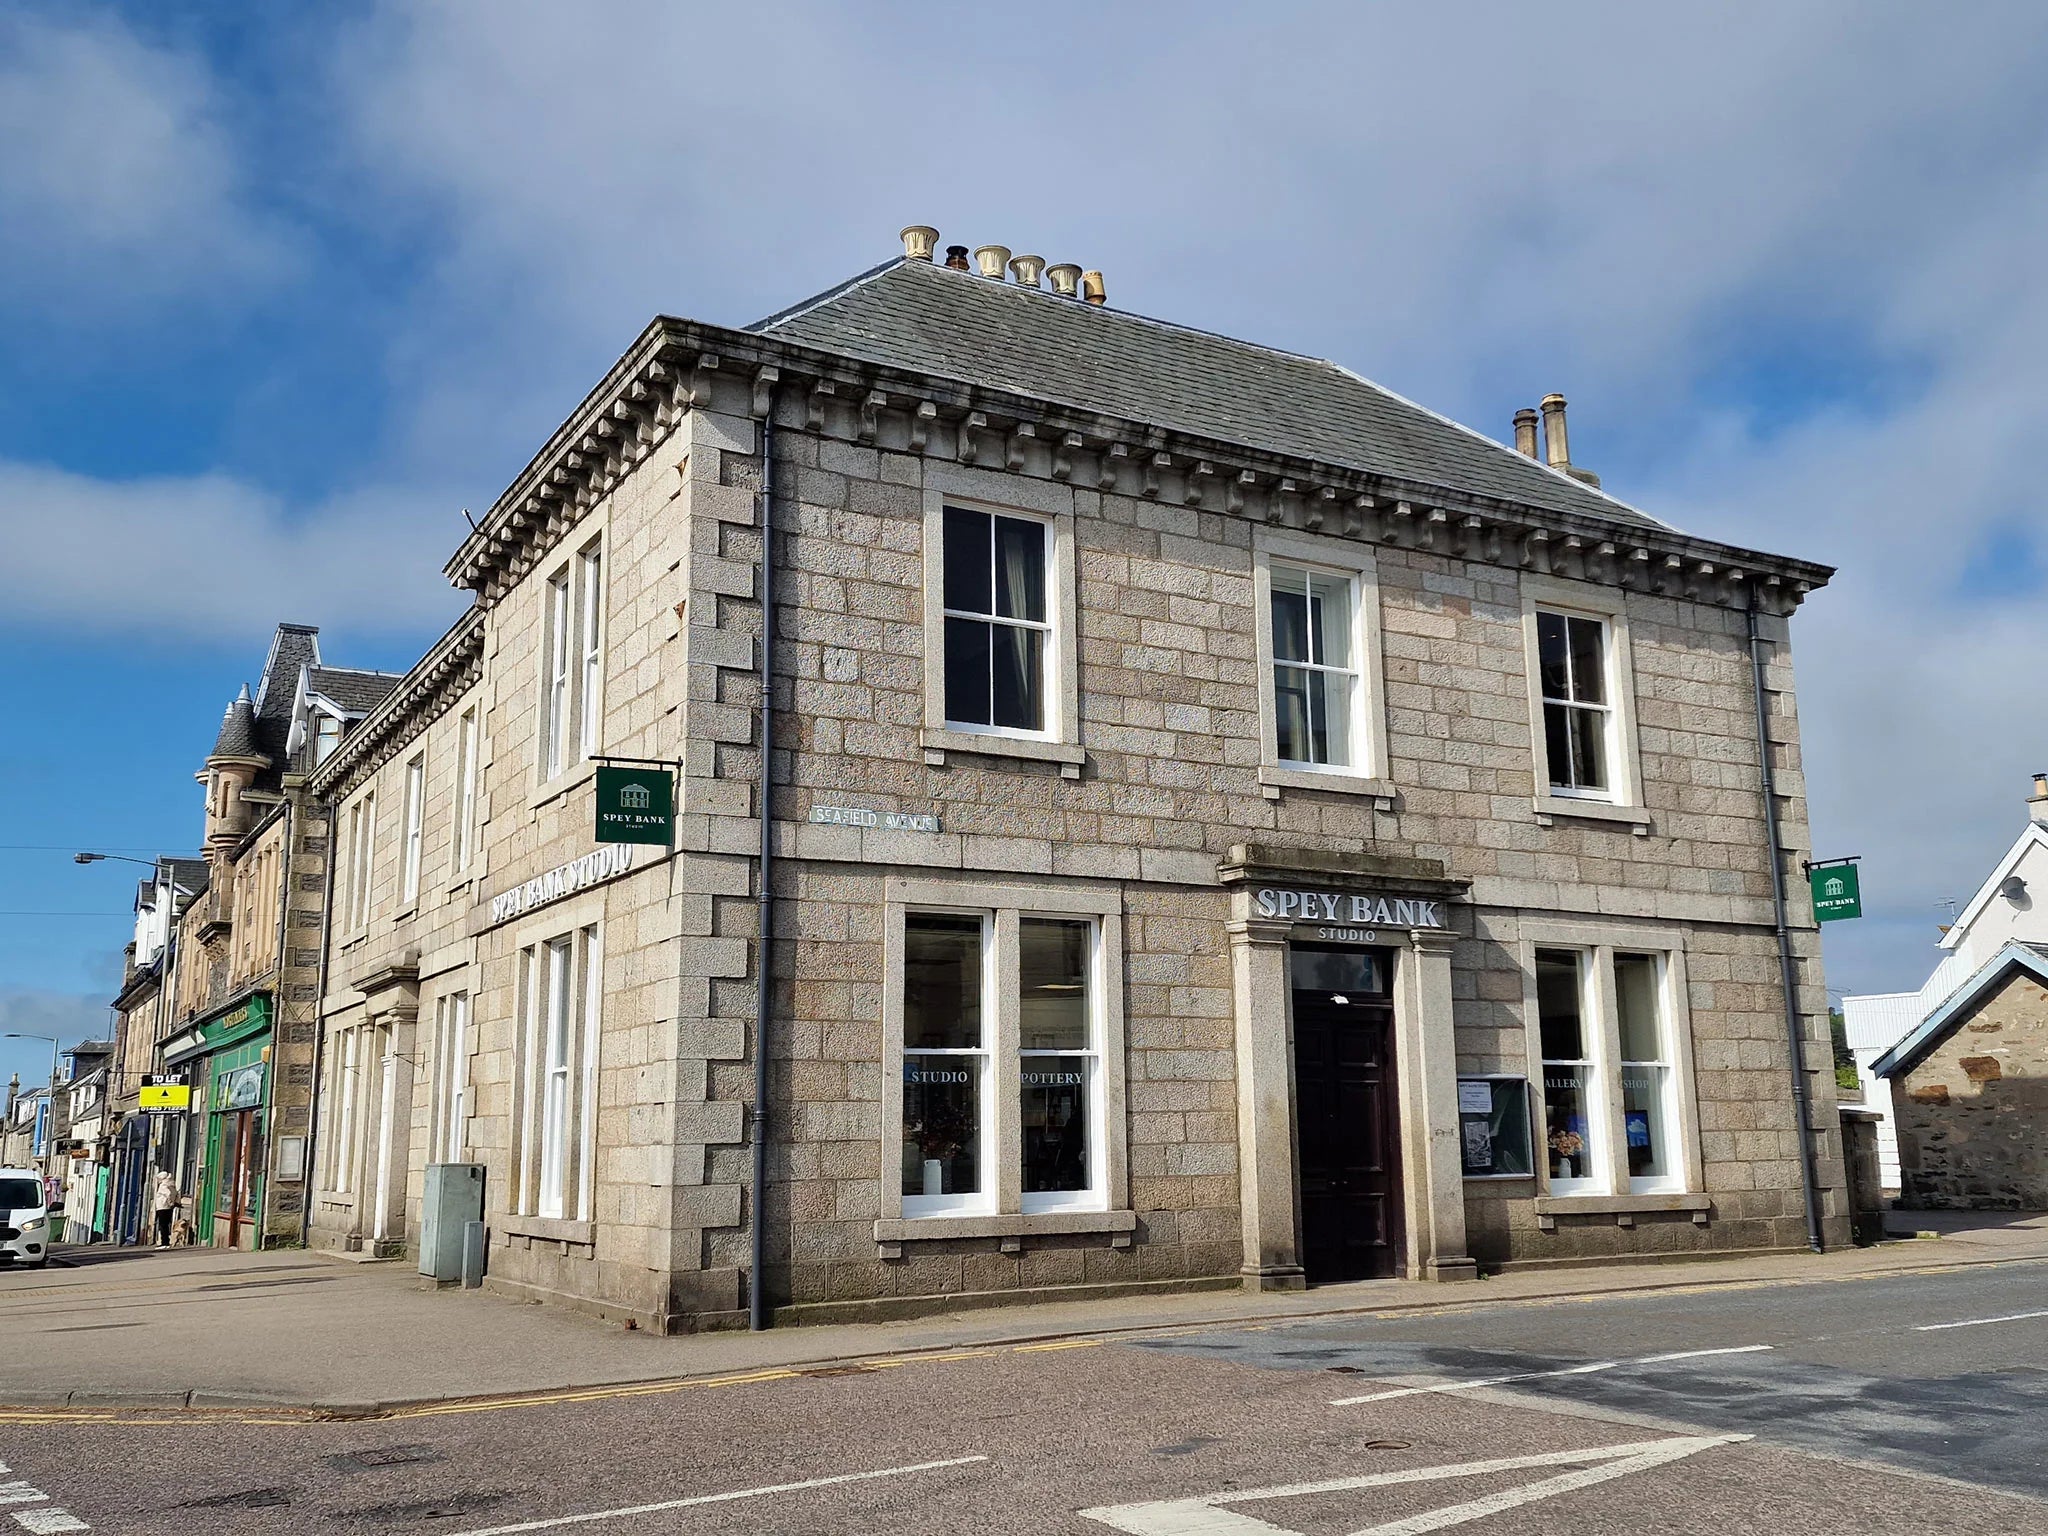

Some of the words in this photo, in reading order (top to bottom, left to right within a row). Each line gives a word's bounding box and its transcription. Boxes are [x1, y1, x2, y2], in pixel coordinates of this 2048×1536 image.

[603, 813, 631, 822] SPEY
[635, 815, 665, 824] BANK
[816, 808, 877, 826] SEAFIELD
[884, 814, 933, 831] AVENUE
[493, 884, 525, 924] SPEY
[527, 866, 567, 909] BANK
[569, 843, 633, 892] STUDIO
[1258, 889, 1341, 921] SPEY
[1349, 895, 1442, 928] BANK
[1318, 927, 1376, 942] STUDIO
[151, 1074, 164, 1083] TO
[165, 1074, 182, 1083] LET
[911, 1071, 968, 1083] STUDIO
[1021, 1072, 1083, 1084] POTTERY
[1545, 1078, 1583, 1089] ALLERY
[1623, 1080, 1649, 1089] SHOP
